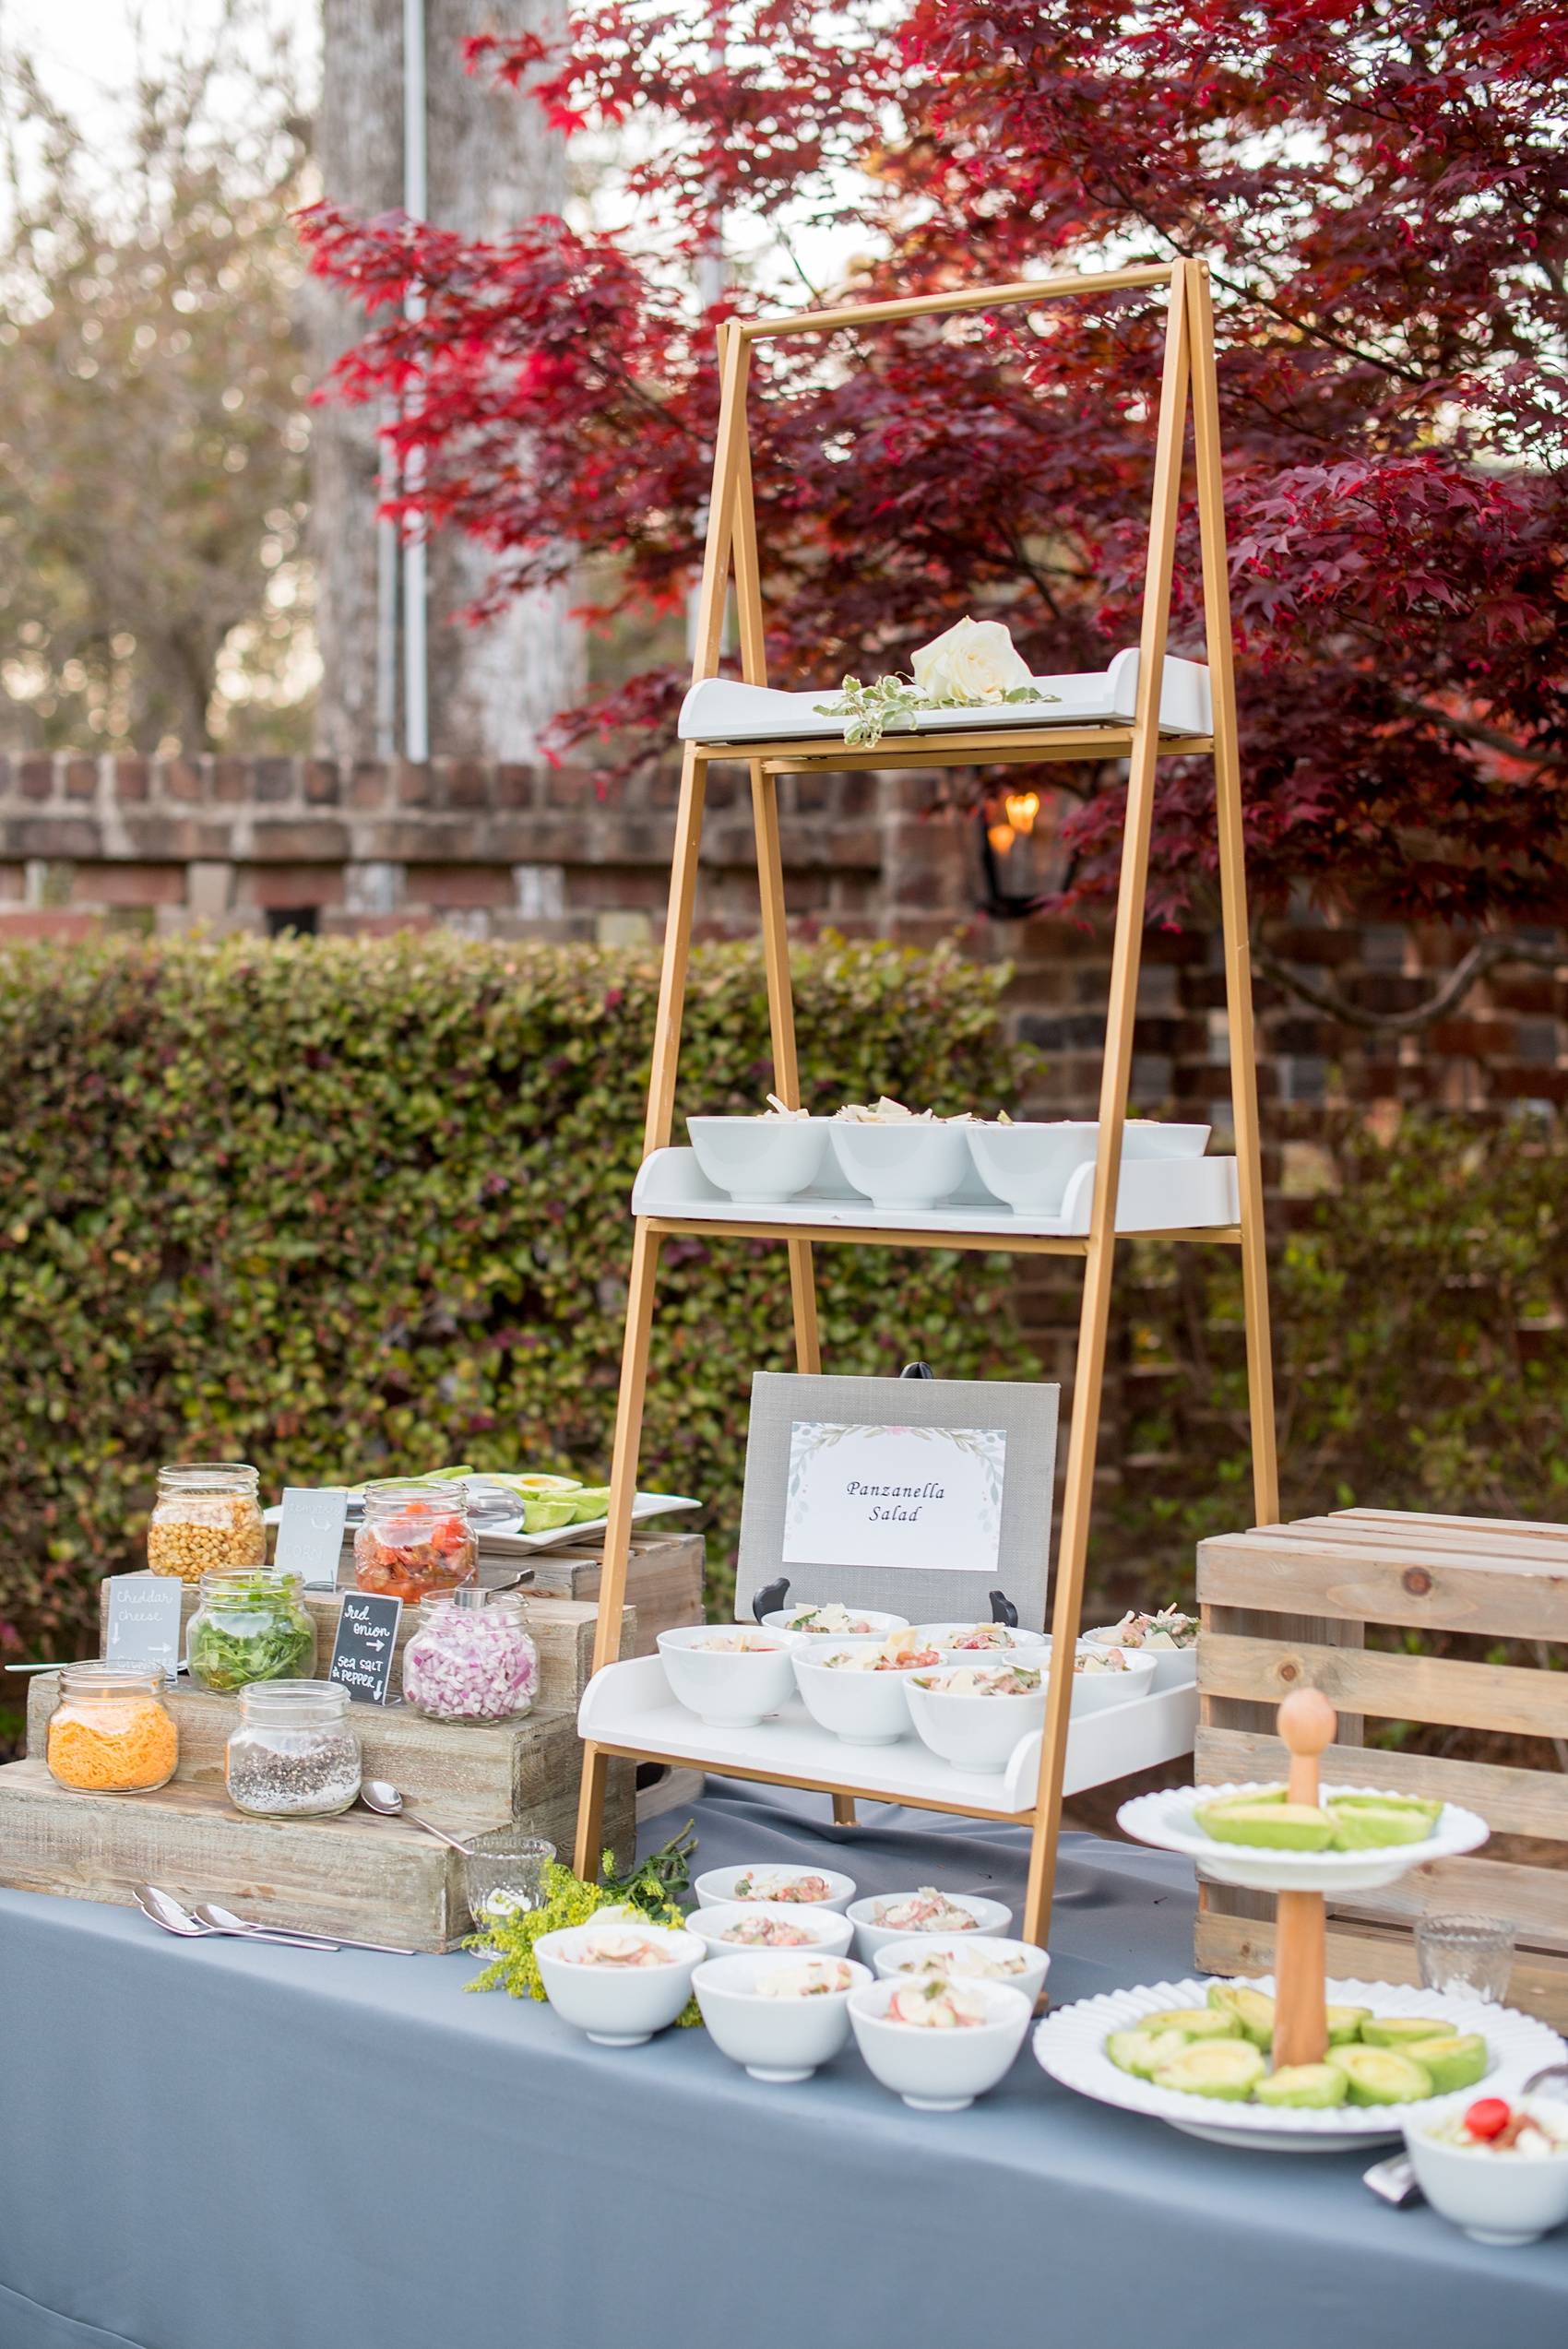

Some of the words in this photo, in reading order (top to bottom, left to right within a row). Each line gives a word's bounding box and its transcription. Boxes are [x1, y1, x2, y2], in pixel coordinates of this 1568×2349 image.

[847, 1481, 944, 1499] Panzanella
[869, 1505, 922, 1522] Salad
[284, 1542, 323, 1560] CORN
[344, 1604, 370, 1620] red
[353, 1621, 390, 1637] onion
